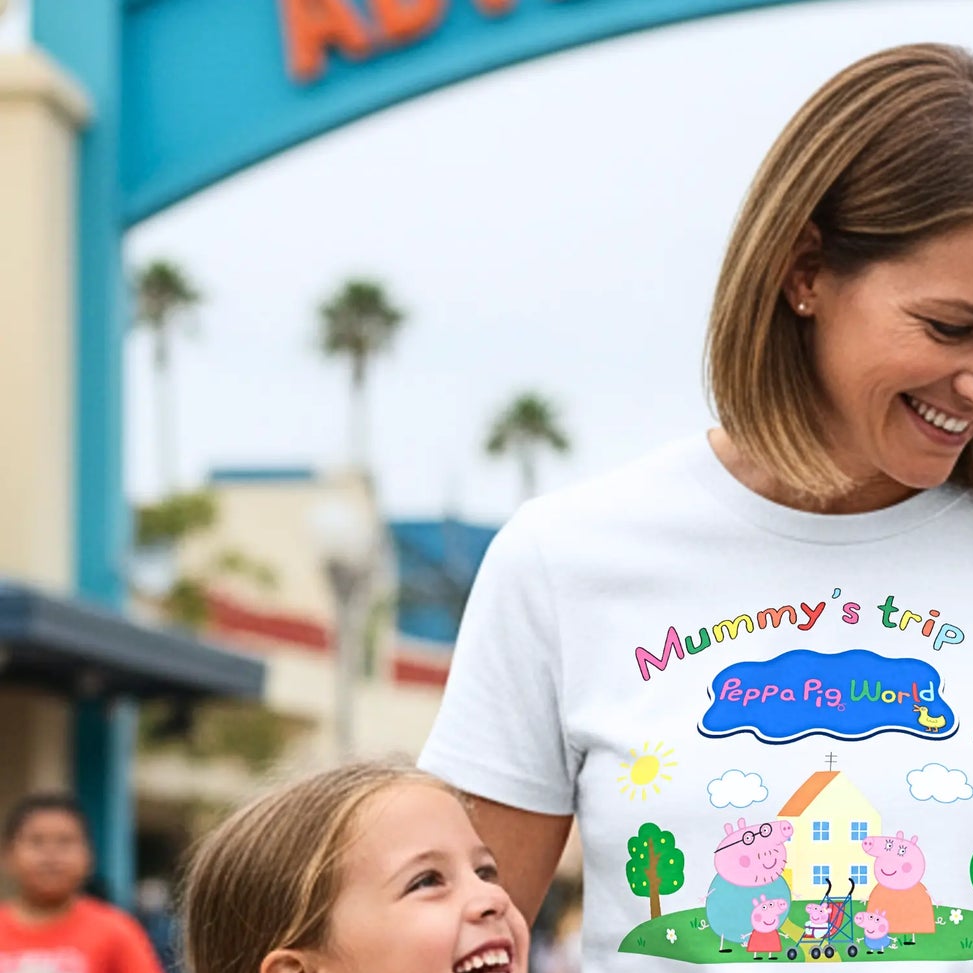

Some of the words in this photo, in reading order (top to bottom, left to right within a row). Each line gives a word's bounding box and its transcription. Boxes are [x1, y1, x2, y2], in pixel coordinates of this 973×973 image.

[634, 587, 861, 681] Mummy's
[877, 595, 965, 651] trip
[719, 677, 796, 706] Peppa
[803, 678, 843, 708] Pig
[850, 680, 935, 704] World
